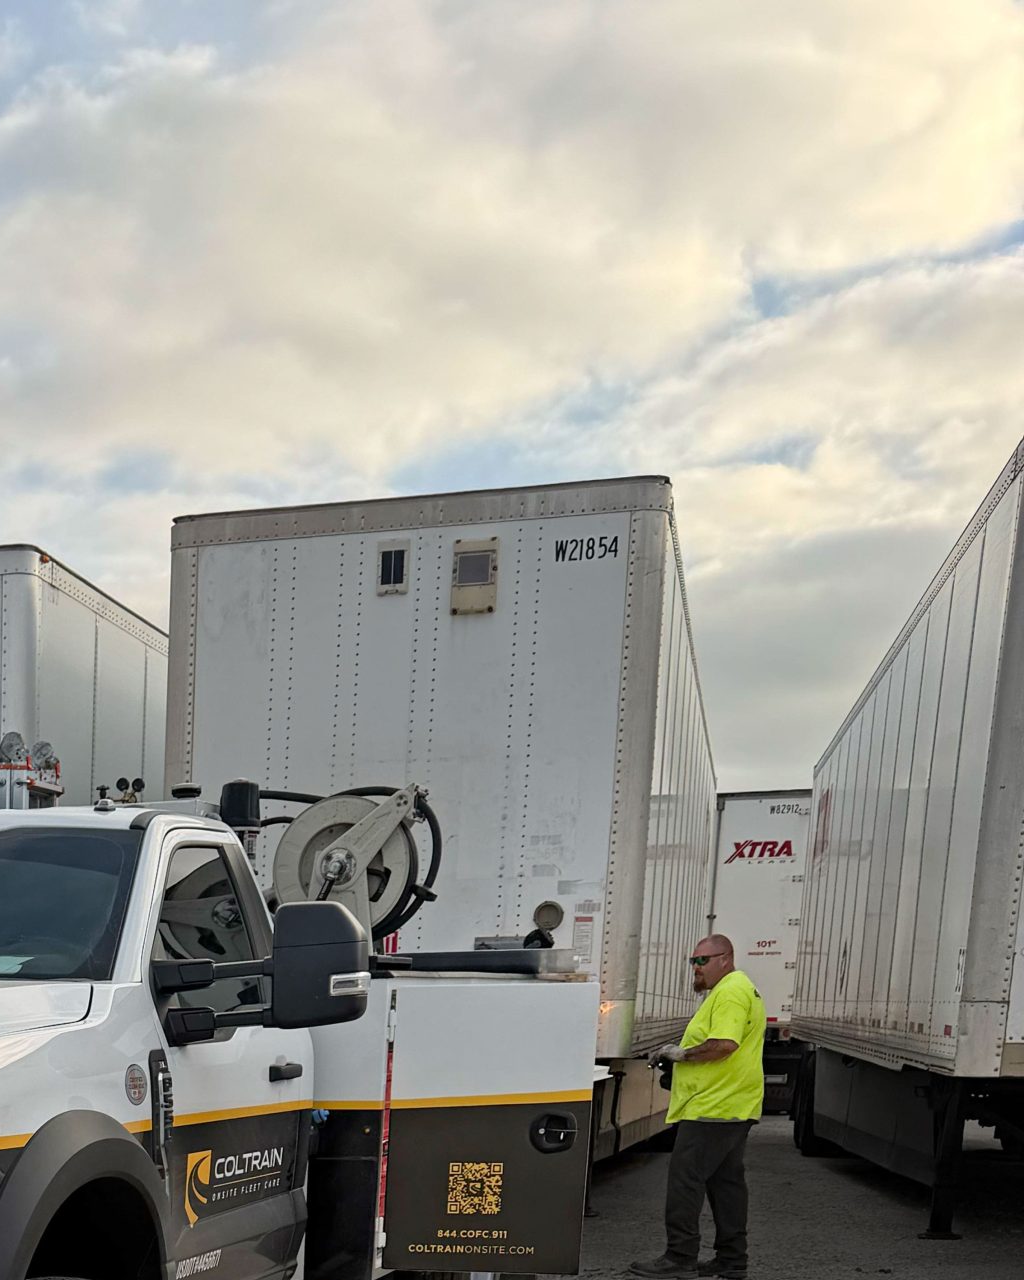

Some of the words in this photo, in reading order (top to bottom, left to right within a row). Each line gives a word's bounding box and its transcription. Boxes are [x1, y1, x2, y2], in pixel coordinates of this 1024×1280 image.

[554, 535, 619, 562] W21854
[724, 840, 793, 864] XTRA
[214, 1147, 284, 1179] COLTRAIN
[212, 1188, 238, 1202] ONSITE
[240, 1182, 261, 1196] FLEET
[264, 1178, 280, 1190] CARE
[408, 1244, 534, 1255] COLTRAINONSITE.COM
